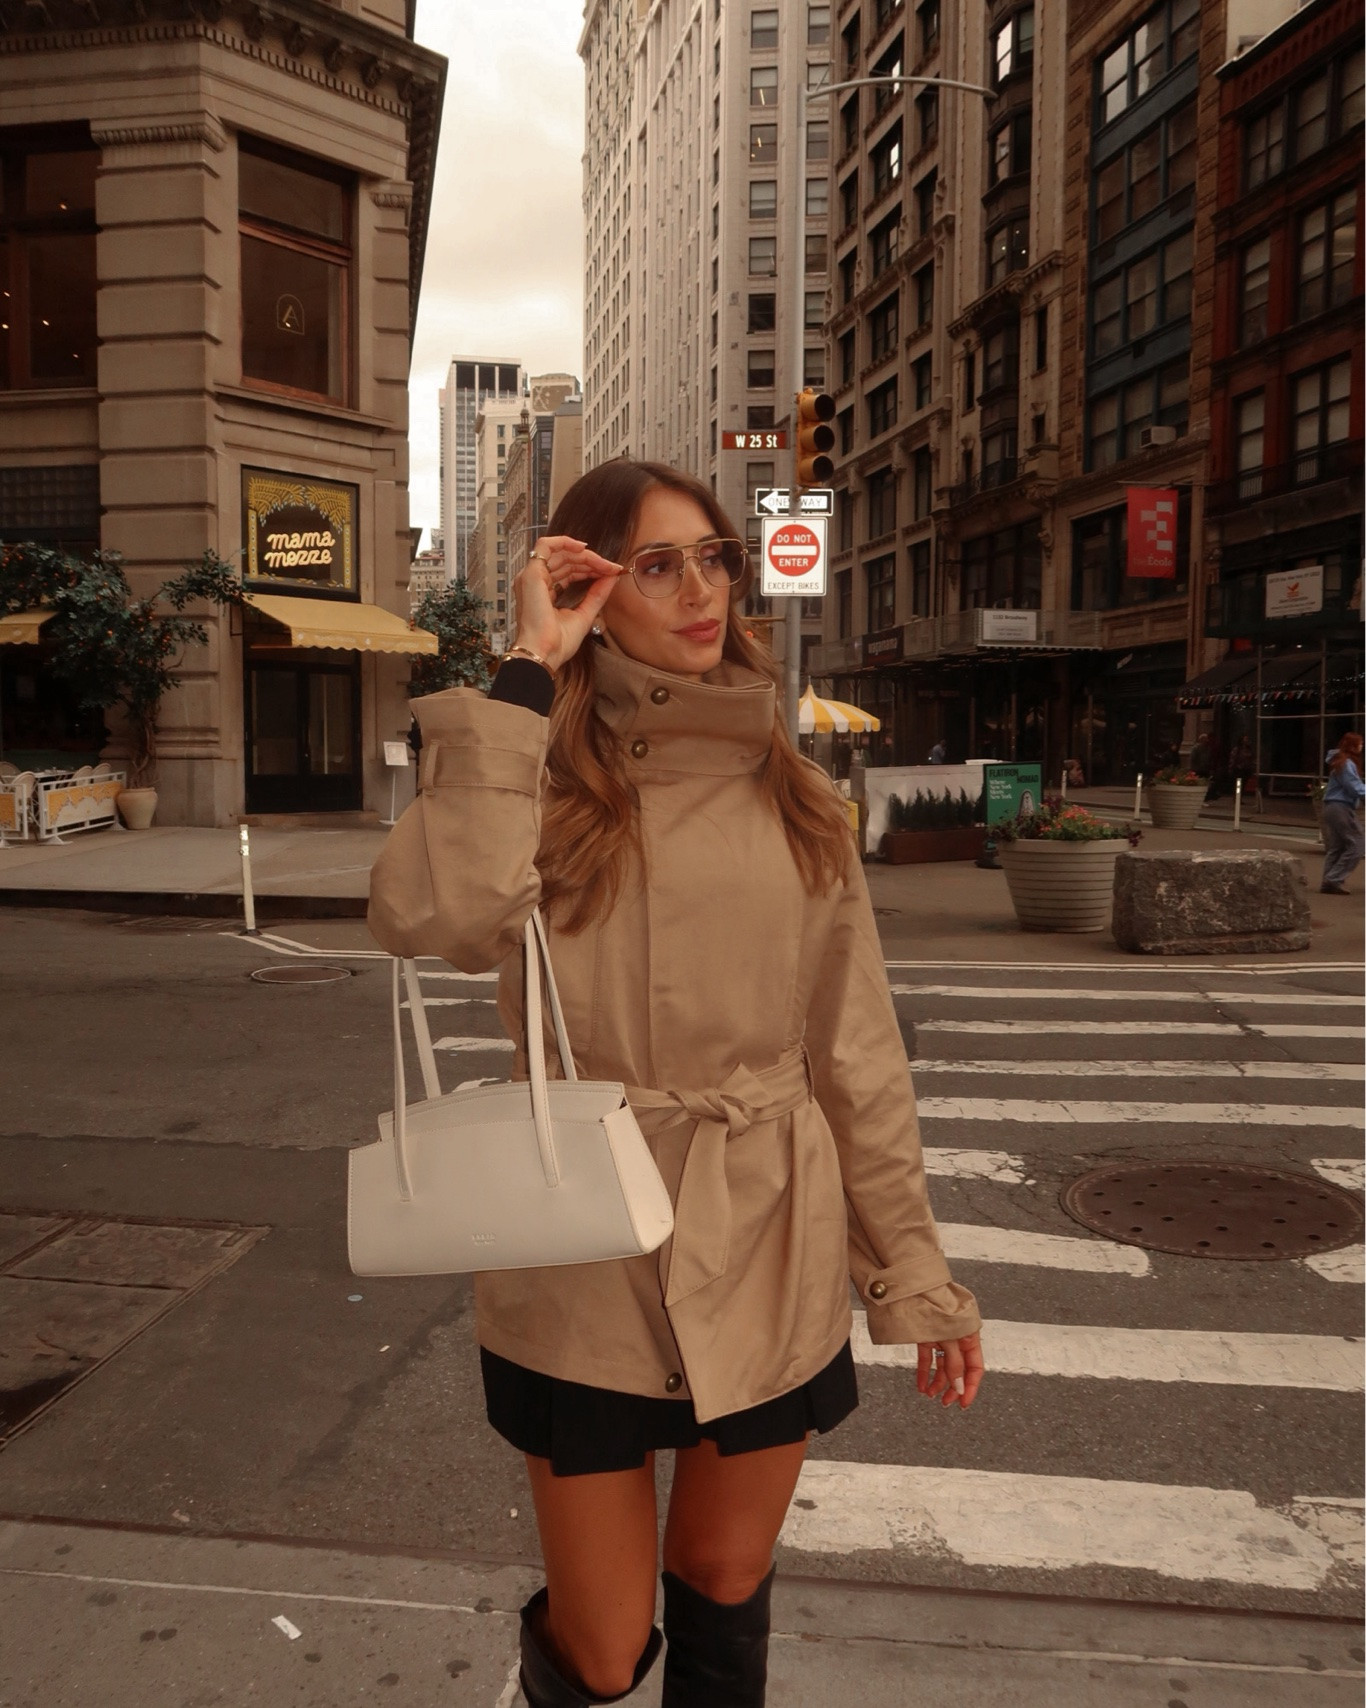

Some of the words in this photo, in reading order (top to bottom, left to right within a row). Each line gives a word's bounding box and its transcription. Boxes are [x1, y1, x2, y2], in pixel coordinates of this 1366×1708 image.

[735, 434, 746, 448] W
[750, 434, 762, 448] 25
[766, 434, 778, 448] St
[768, 498, 789, 507] ONE
[801, 498, 822, 507] WAY
[267, 531, 335, 550] mama
[777, 534, 790, 543] DO
[793, 534, 812, 543] NOT
[264, 549, 333, 568] mezze
[778, 558, 809, 567] ENTER
[767, 582, 795, 590] EXCEPT
[798, 582, 819, 590] BIKES
